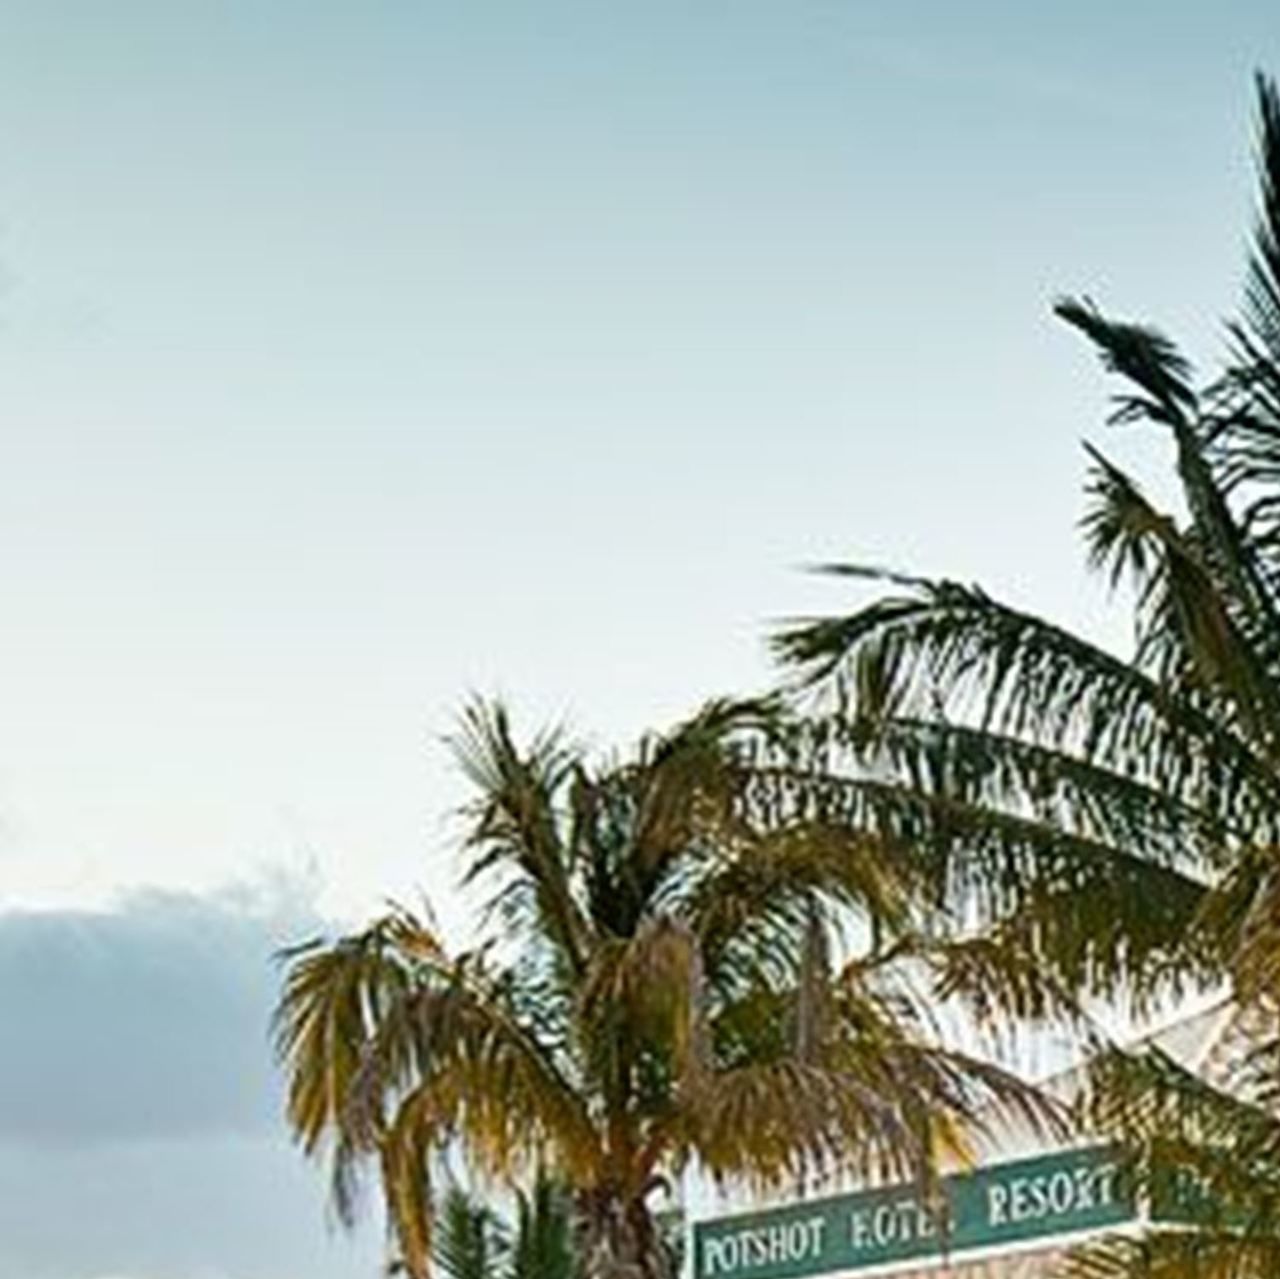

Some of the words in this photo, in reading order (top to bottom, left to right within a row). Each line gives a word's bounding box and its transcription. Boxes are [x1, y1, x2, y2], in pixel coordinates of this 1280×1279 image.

[702, 1217, 826, 1276] POTSHOT
[851, 1193, 956, 1249] HOTE
[988, 1164, 1117, 1228] RESORT
